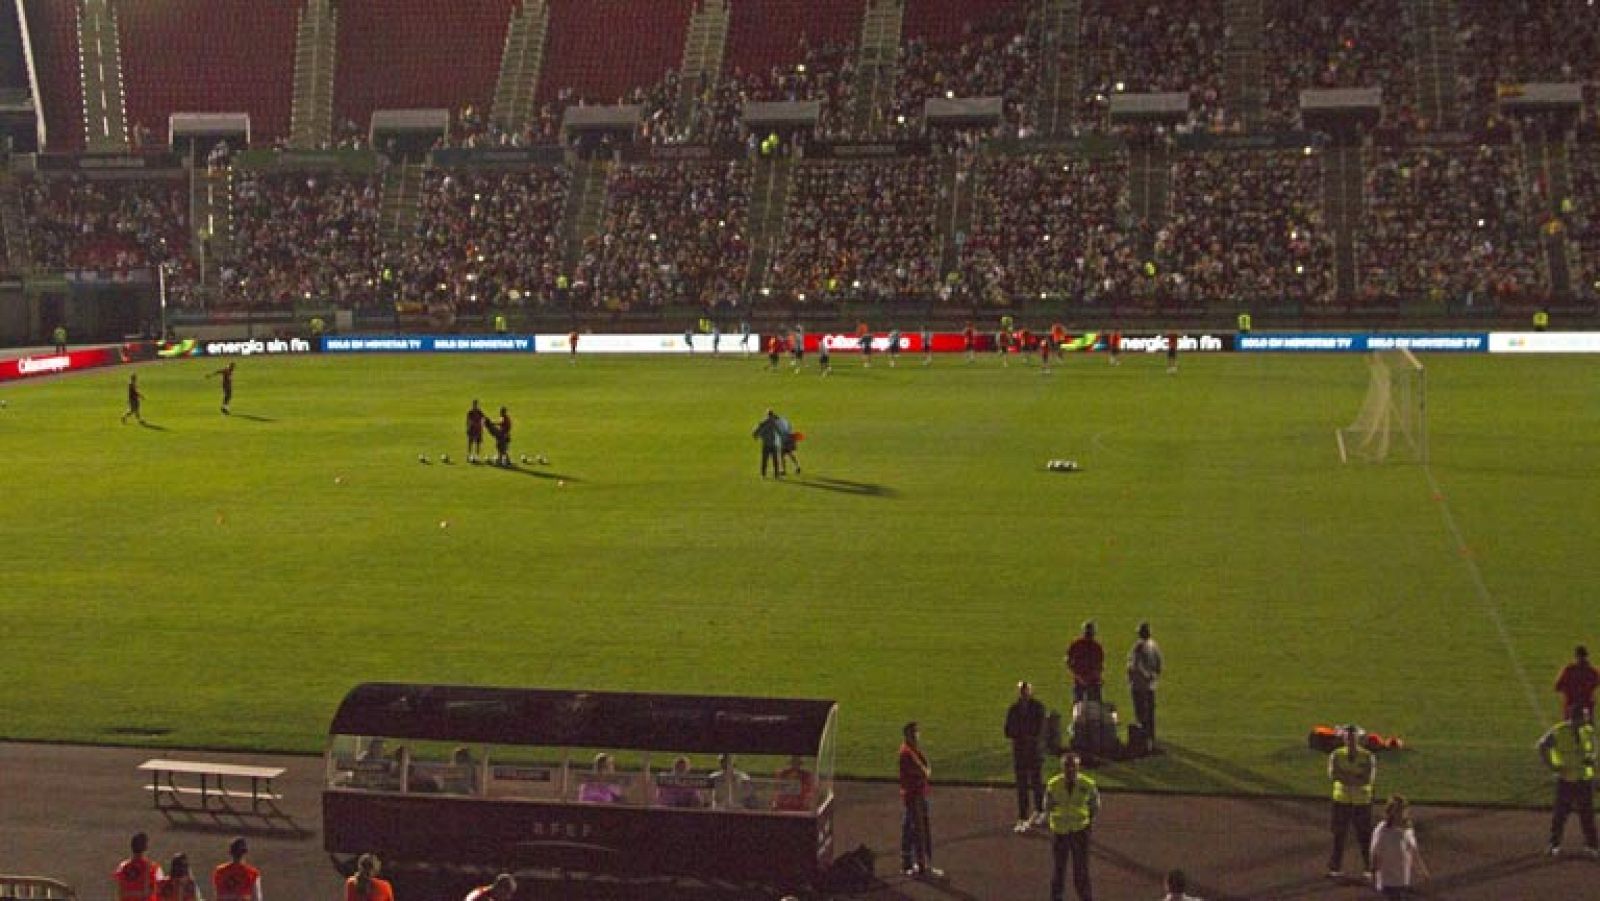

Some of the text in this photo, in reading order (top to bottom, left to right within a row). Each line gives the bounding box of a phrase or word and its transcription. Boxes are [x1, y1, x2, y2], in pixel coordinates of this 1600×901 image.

[266, 337, 288, 351] sin
[291, 337, 310, 351] fin
[410, 339, 421, 349] TV
[514, 339, 528, 349] TV
[1120, 335, 1222, 352] nergia sin fin
[1337, 337, 1353, 348] TV
[1465, 337, 1481, 348] TV
